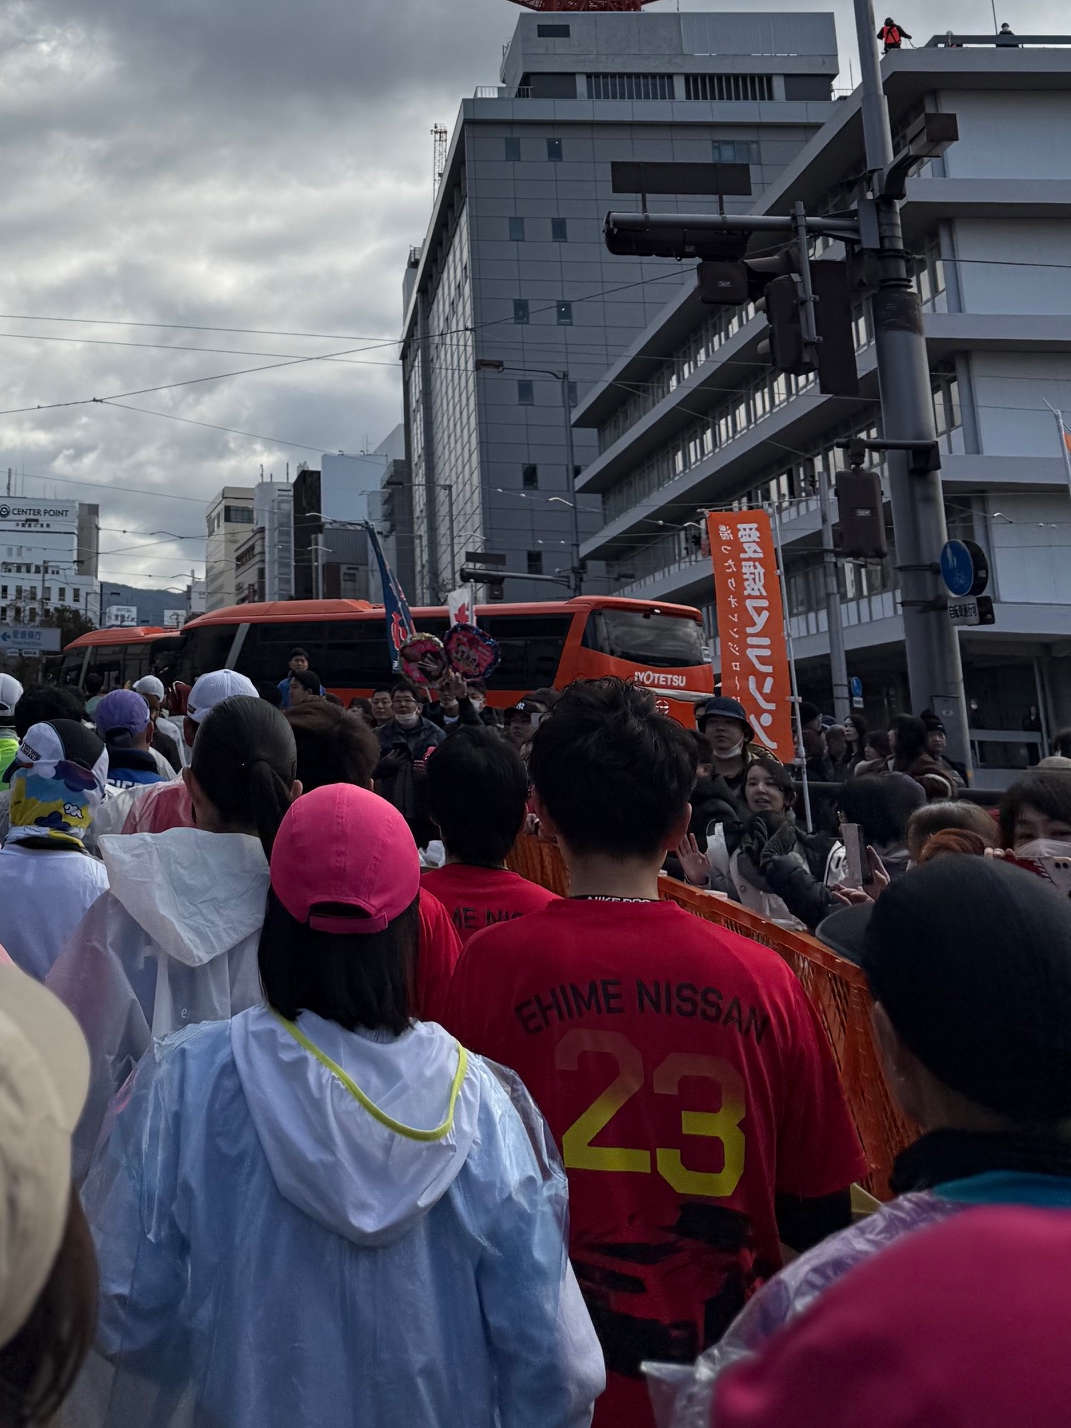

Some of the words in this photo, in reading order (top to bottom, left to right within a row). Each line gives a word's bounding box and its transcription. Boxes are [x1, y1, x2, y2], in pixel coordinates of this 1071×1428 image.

[12, 508, 42, 517] CENTER
[43, 508, 69, 517] POINT
[634, 671, 686, 687] IYOTETSU
[514, 979, 625, 1036] EHIME
[636, 979, 769, 1045] NISSAN
[554, 1027, 746, 1197] 23
